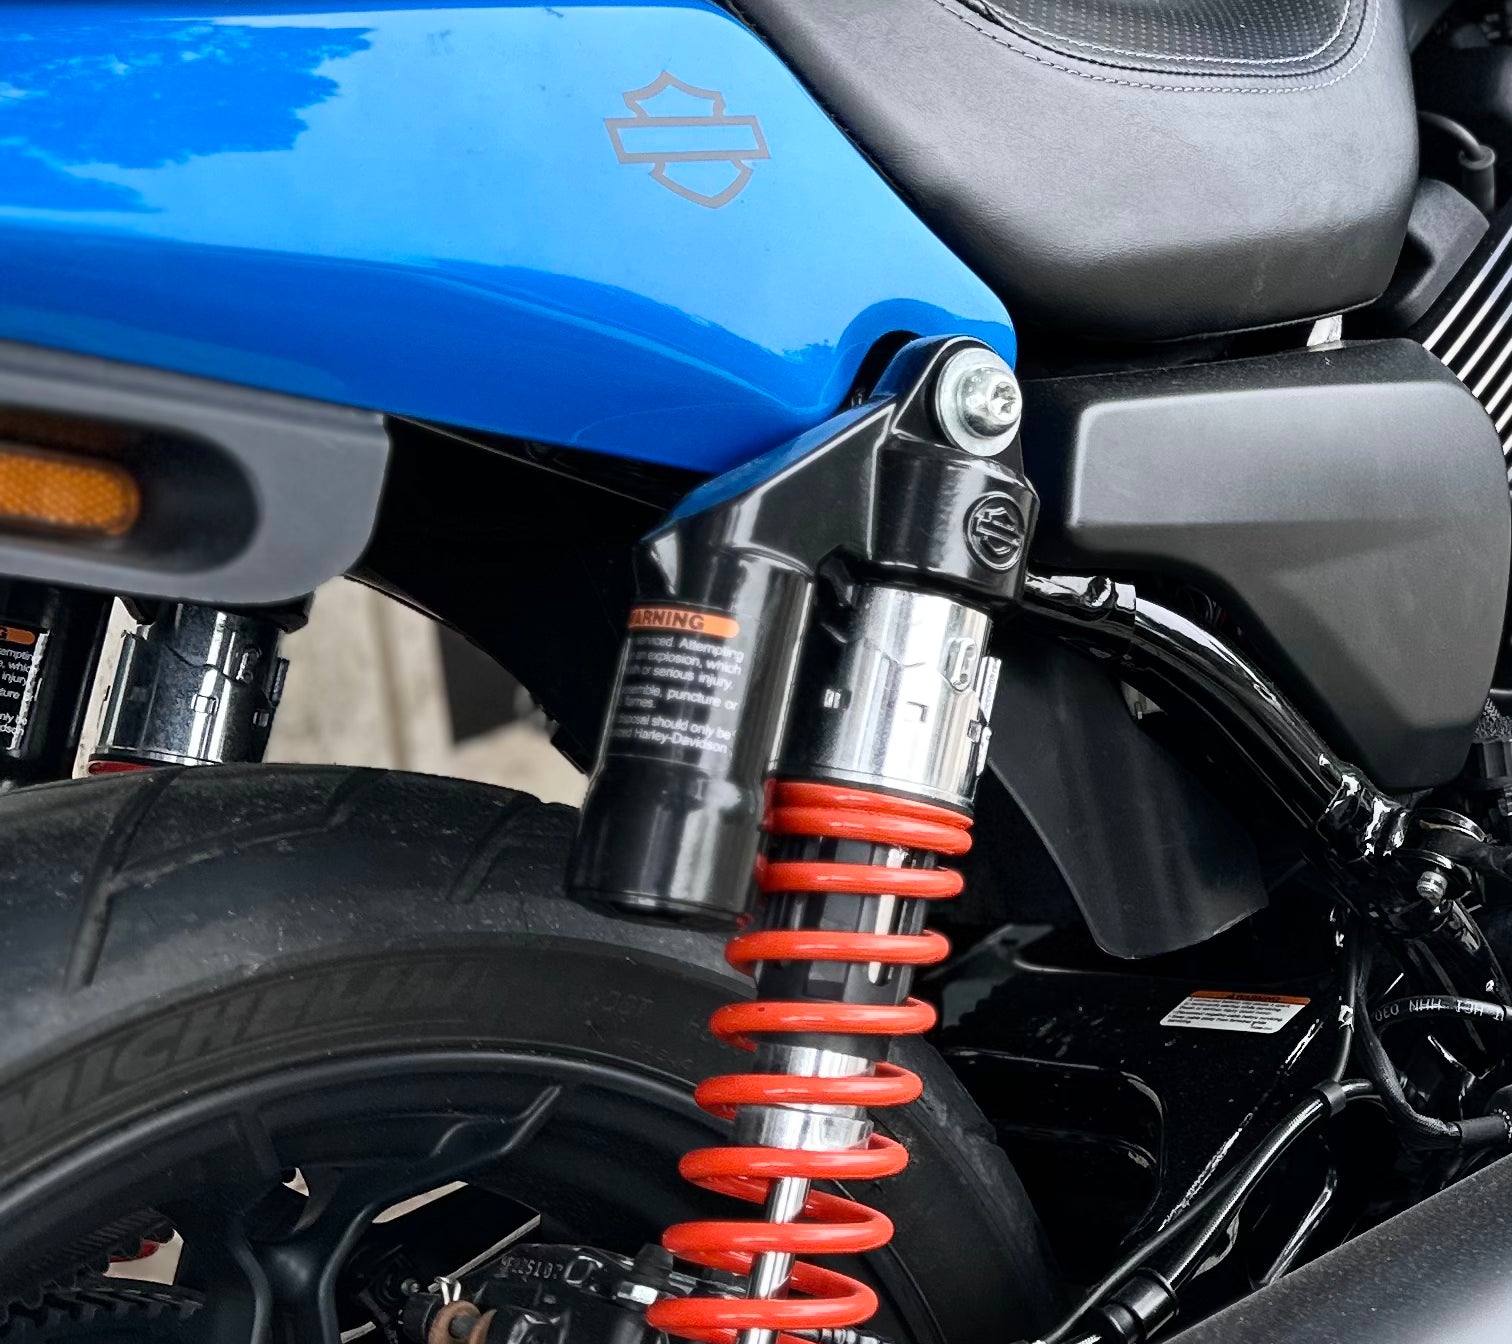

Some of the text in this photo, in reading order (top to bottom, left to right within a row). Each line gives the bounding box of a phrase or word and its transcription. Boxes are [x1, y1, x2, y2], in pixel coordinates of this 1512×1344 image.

[679, 638, 745, 664] Attempting
[653, 667, 695, 682] serious
[705, 659, 742, 675] which
[667, 688, 722, 707] puncture
[651, 715, 689, 731] should
[690, 723, 715, 739] only
[633, 727, 728, 754] Harley-Davidson
